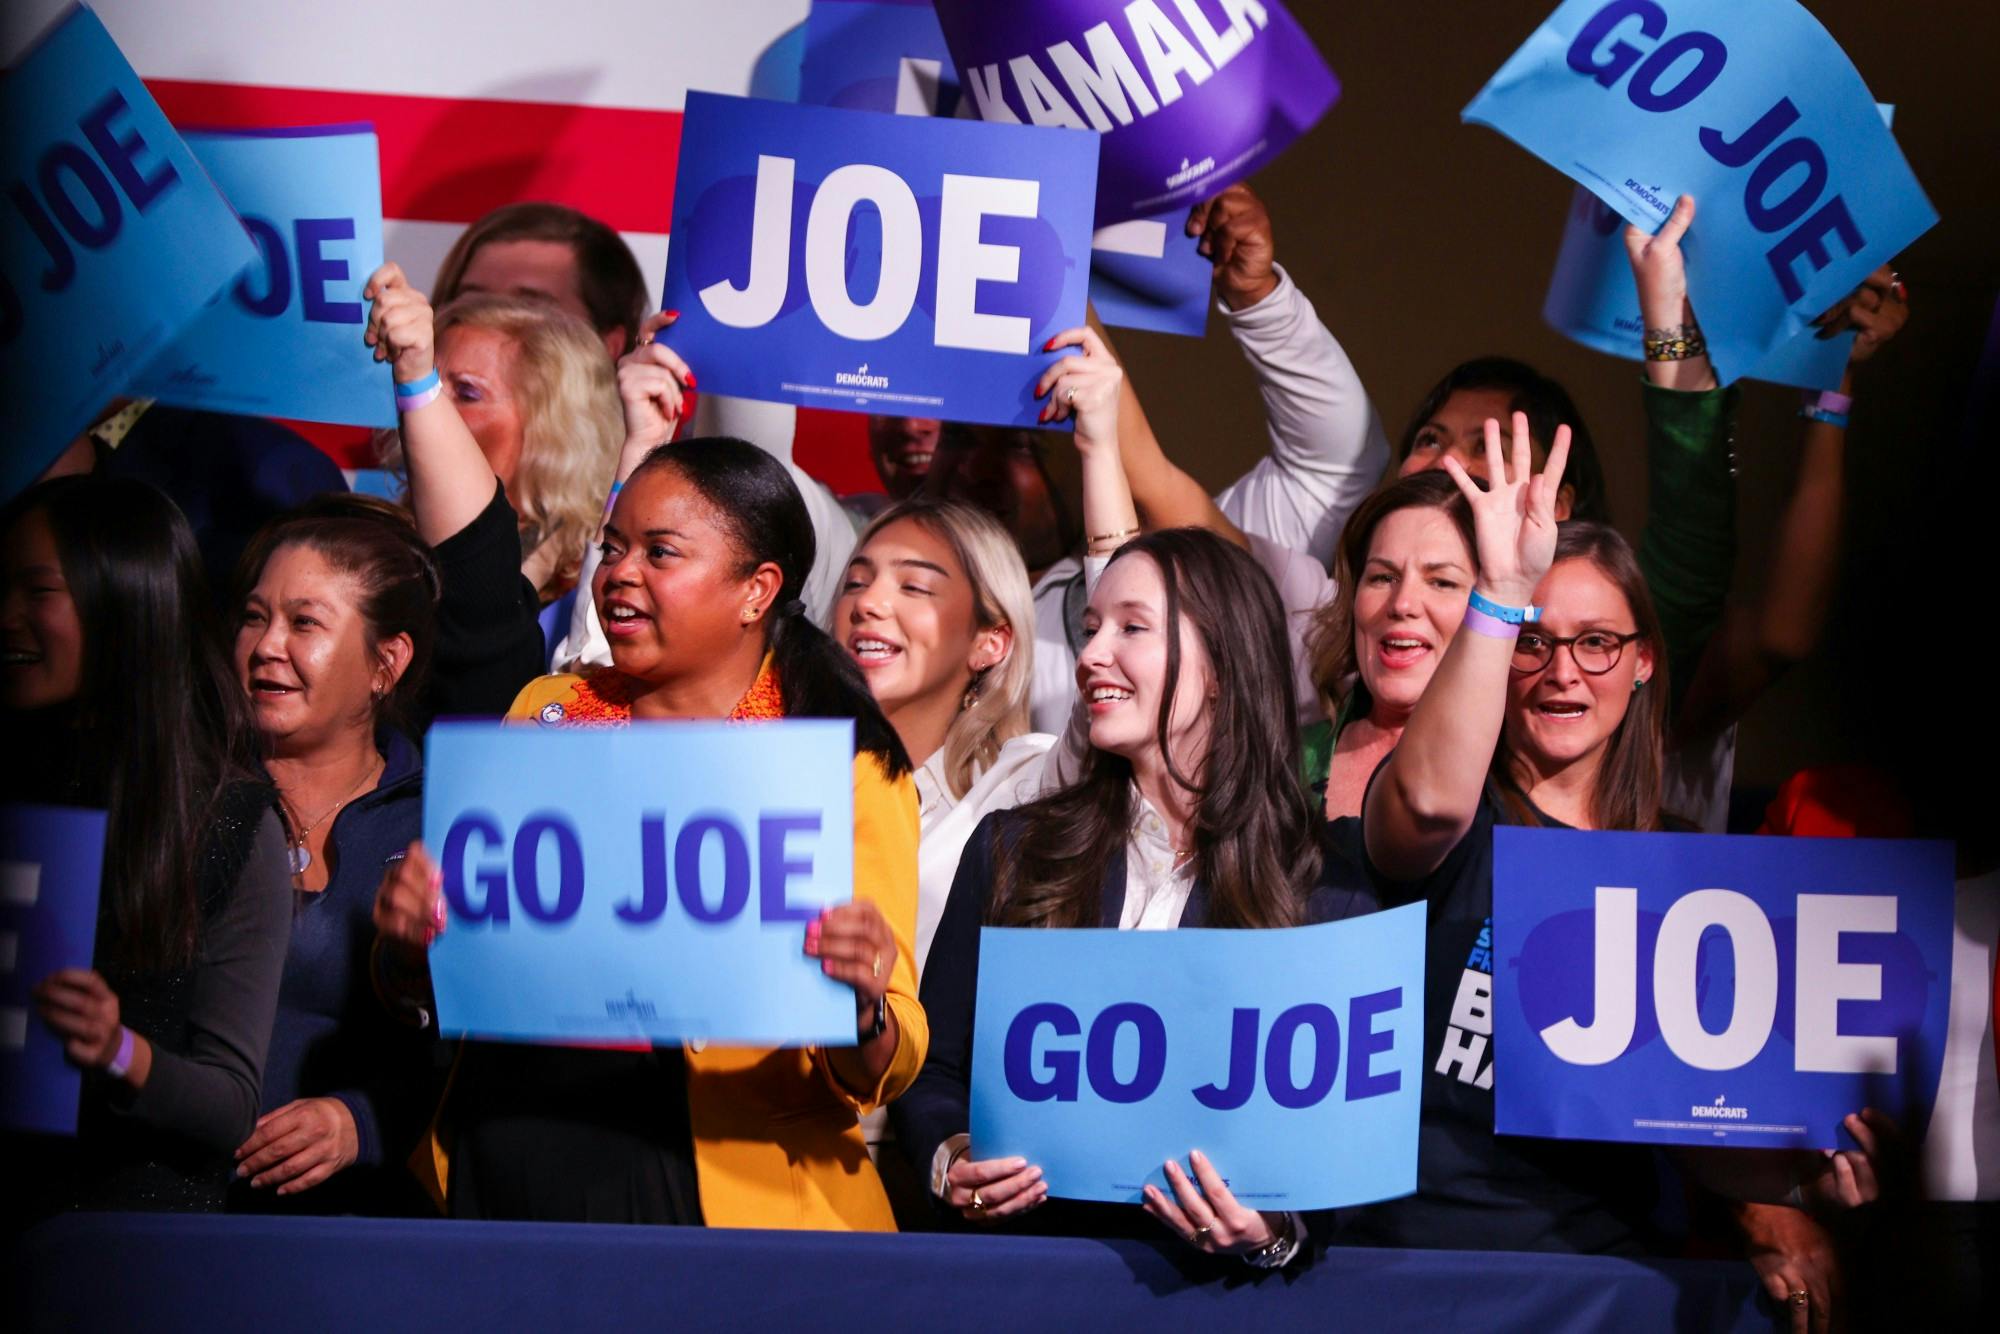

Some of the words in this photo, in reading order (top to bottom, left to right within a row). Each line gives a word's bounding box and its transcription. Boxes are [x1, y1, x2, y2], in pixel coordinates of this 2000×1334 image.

[6, 88, 183, 293] JOE
[1566, 0, 1727, 113] GO
[1699, 96, 1868, 304] JOE
[1624, 178, 1671, 215] DEMOCRATS
[205, 213, 363, 324] OE
[699, 154, 1041, 355] JOE
[836, 372, 889, 389] DEMOCRATS
[441, 808, 585, 928] GO
[613, 809, 823, 927] JOE
[1540, 886, 1898, 1074] JOE
[1003, 1001, 1167, 1104] GO
[1191, 986, 1403, 1111] JOE
[1691, 1105, 1749, 1119] DEMOCRATS
